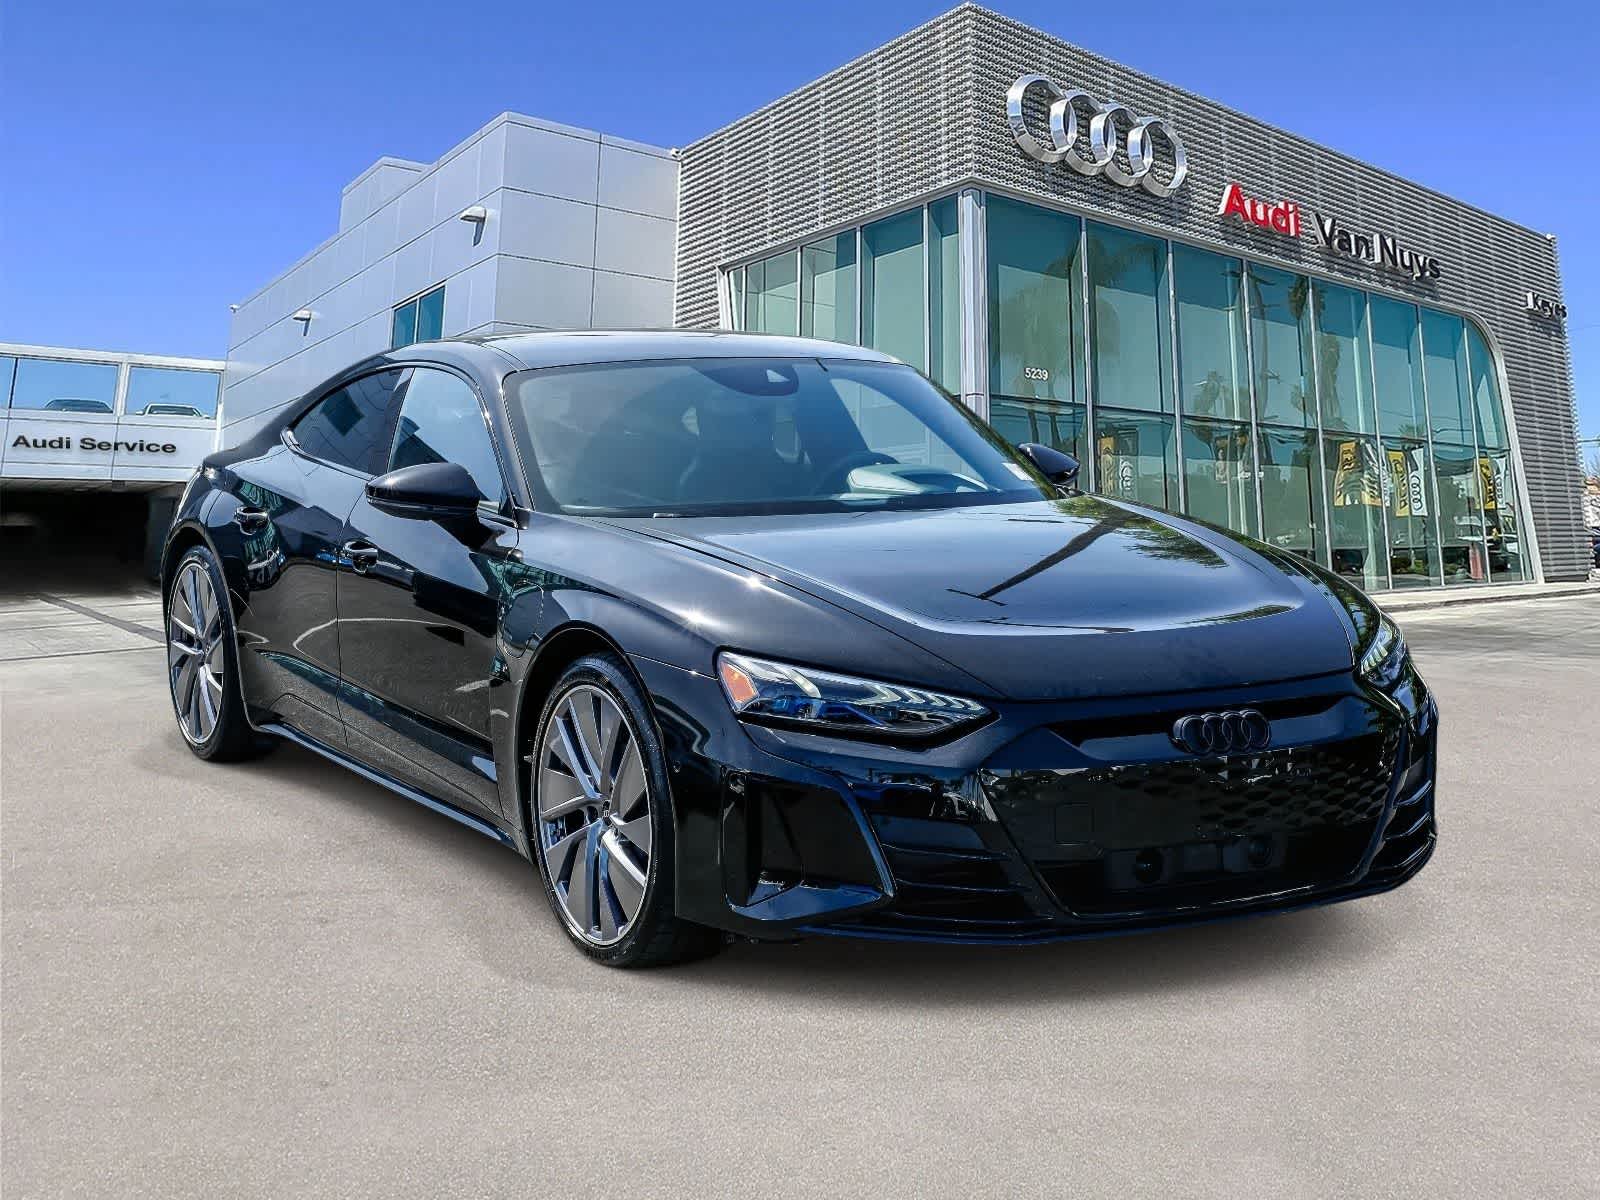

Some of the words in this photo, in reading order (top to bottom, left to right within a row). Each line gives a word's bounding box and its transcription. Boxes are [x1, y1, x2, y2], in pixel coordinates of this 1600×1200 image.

[1220, 183, 1302, 237] Audi
[1312, 211, 1371, 259] Van
[1374, 232, 1442, 280] Nuys
[1526, 291, 1567, 319] Keyes
[1024, 367, 1049, 381] 5239
[12, 435, 71, 450] Audi
[79, 437, 177, 454] Service
